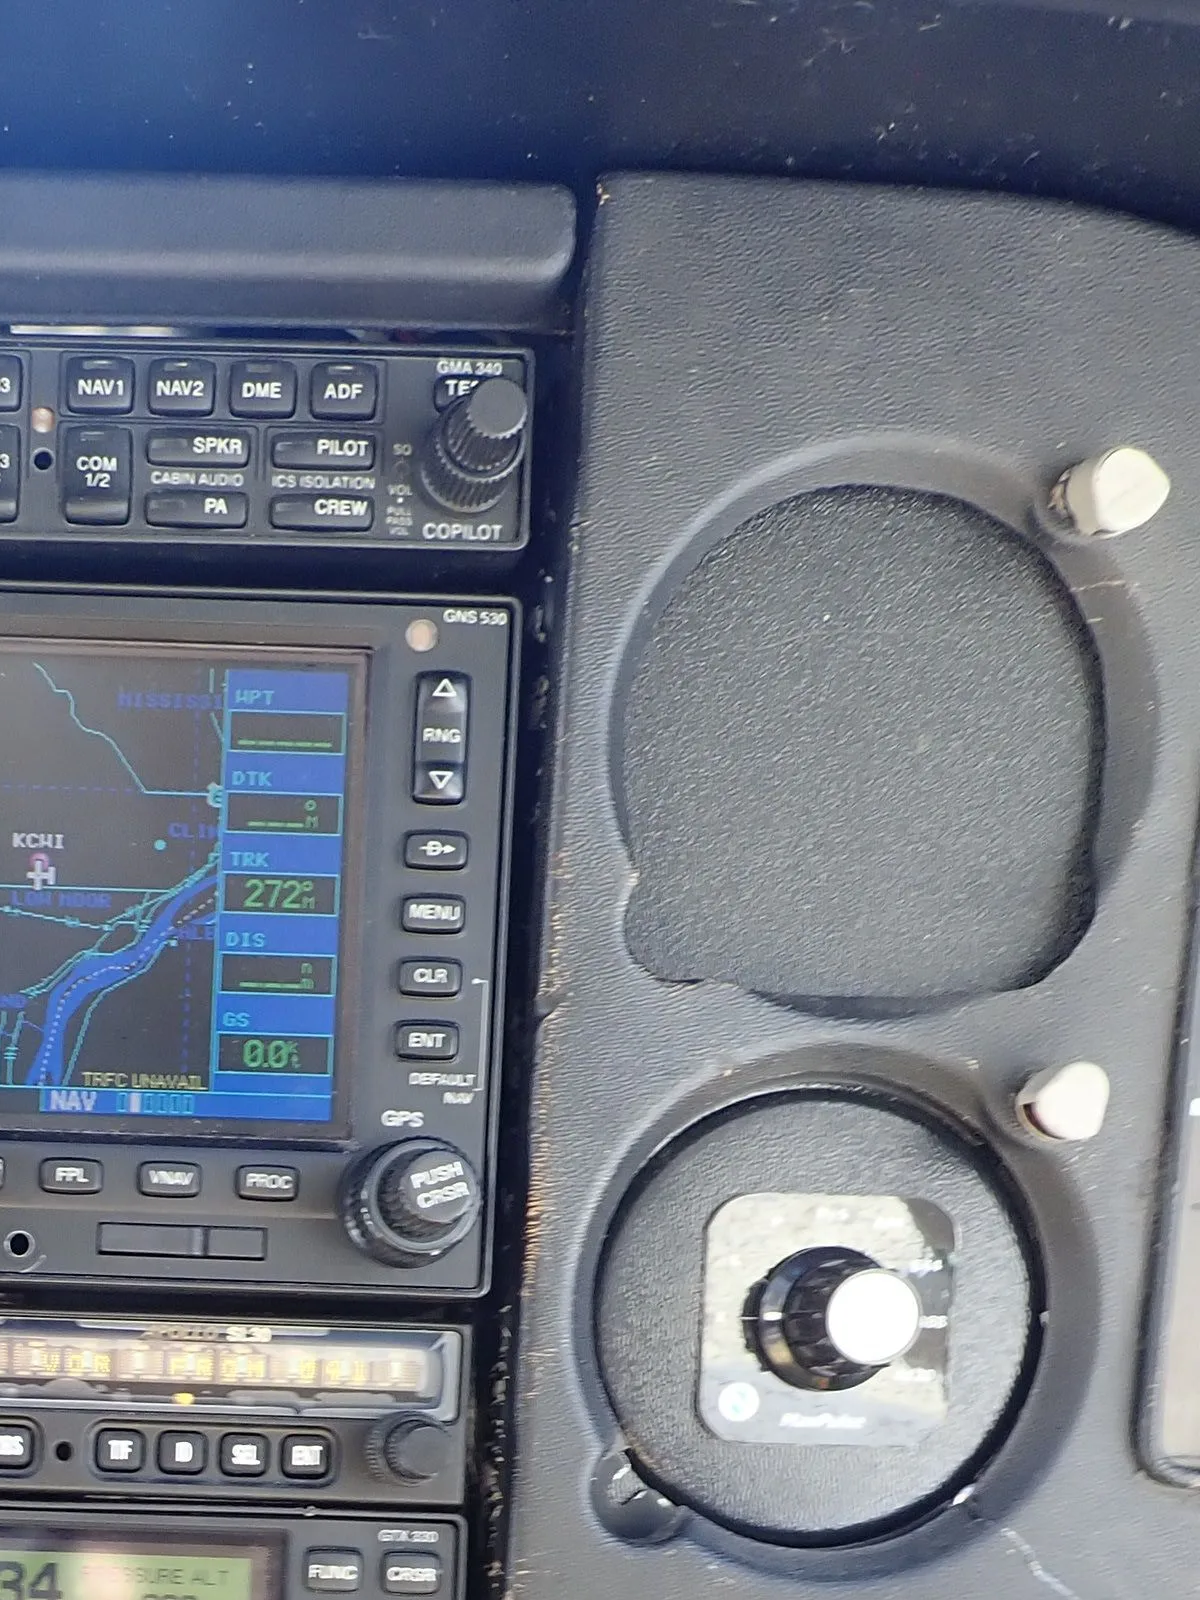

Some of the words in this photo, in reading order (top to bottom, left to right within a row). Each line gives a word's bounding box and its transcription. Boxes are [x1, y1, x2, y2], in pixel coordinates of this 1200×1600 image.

[437, 361, 472, 374] GMA
[474, 362, 503, 375] 340
[78, 380, 124, 395] NAV1
[156, 381, 204, 397] NAV2
[242, 382, 281, 398] DME
[324, 383, 362, 399] ADF
[193, 438, 242, 454] SPKR
[317, 440, 368, 456] PILOT
[76, 456, 117, 472] COM
[85, 472, 110, 487] 1/2
[151, 471, 196, 485] CABIN
[200, 472, 244, 486] AUDIO
[272, 475, 296, 489] ICS
[299, 476, 375, 490] ISOLATION
[387, 485, 412, 496] VOL
[204, 498, 227, 514] PA
[314, 499, 368, 516] CREW
[422, 524, 502, 540] COPILOT
[443, 610, 477, 624] GNS
[480, 611, 507, 626] 530
[422, 728, 461, 743] RNG
[232, 771, 272, 787] DTK
[231, 852, 269, 868] TRK
[409, 904, 461, 920] MENU
[226, 932, 264, 947] DIS
[413, 968, 447, 984] CLR
[223, 1013, 249, 1027] GS
[408, 1033, 445, 1049] ENT
[82, 1071, 128, 1087] TRFC
[131, 1073, 208, 1090] UNAVAIL
[409, 1073, 476, 1086] DEFAULT
[51, 1091, 96, 1111] NAV
[381, 1111, 424, 1127] GPS
[55, 1168, 89, 1183] FPL
[149, 1170, 194, 1186] VNAV
[246, 1173, 293, 1189] PROC
[411, 1162, 464, 1188] PUSH
[416, 1182, 471, 1208] CRSR
[192, 1569, 229, 1585] ALT
[308, 1565, 358, 1580] FUNC
